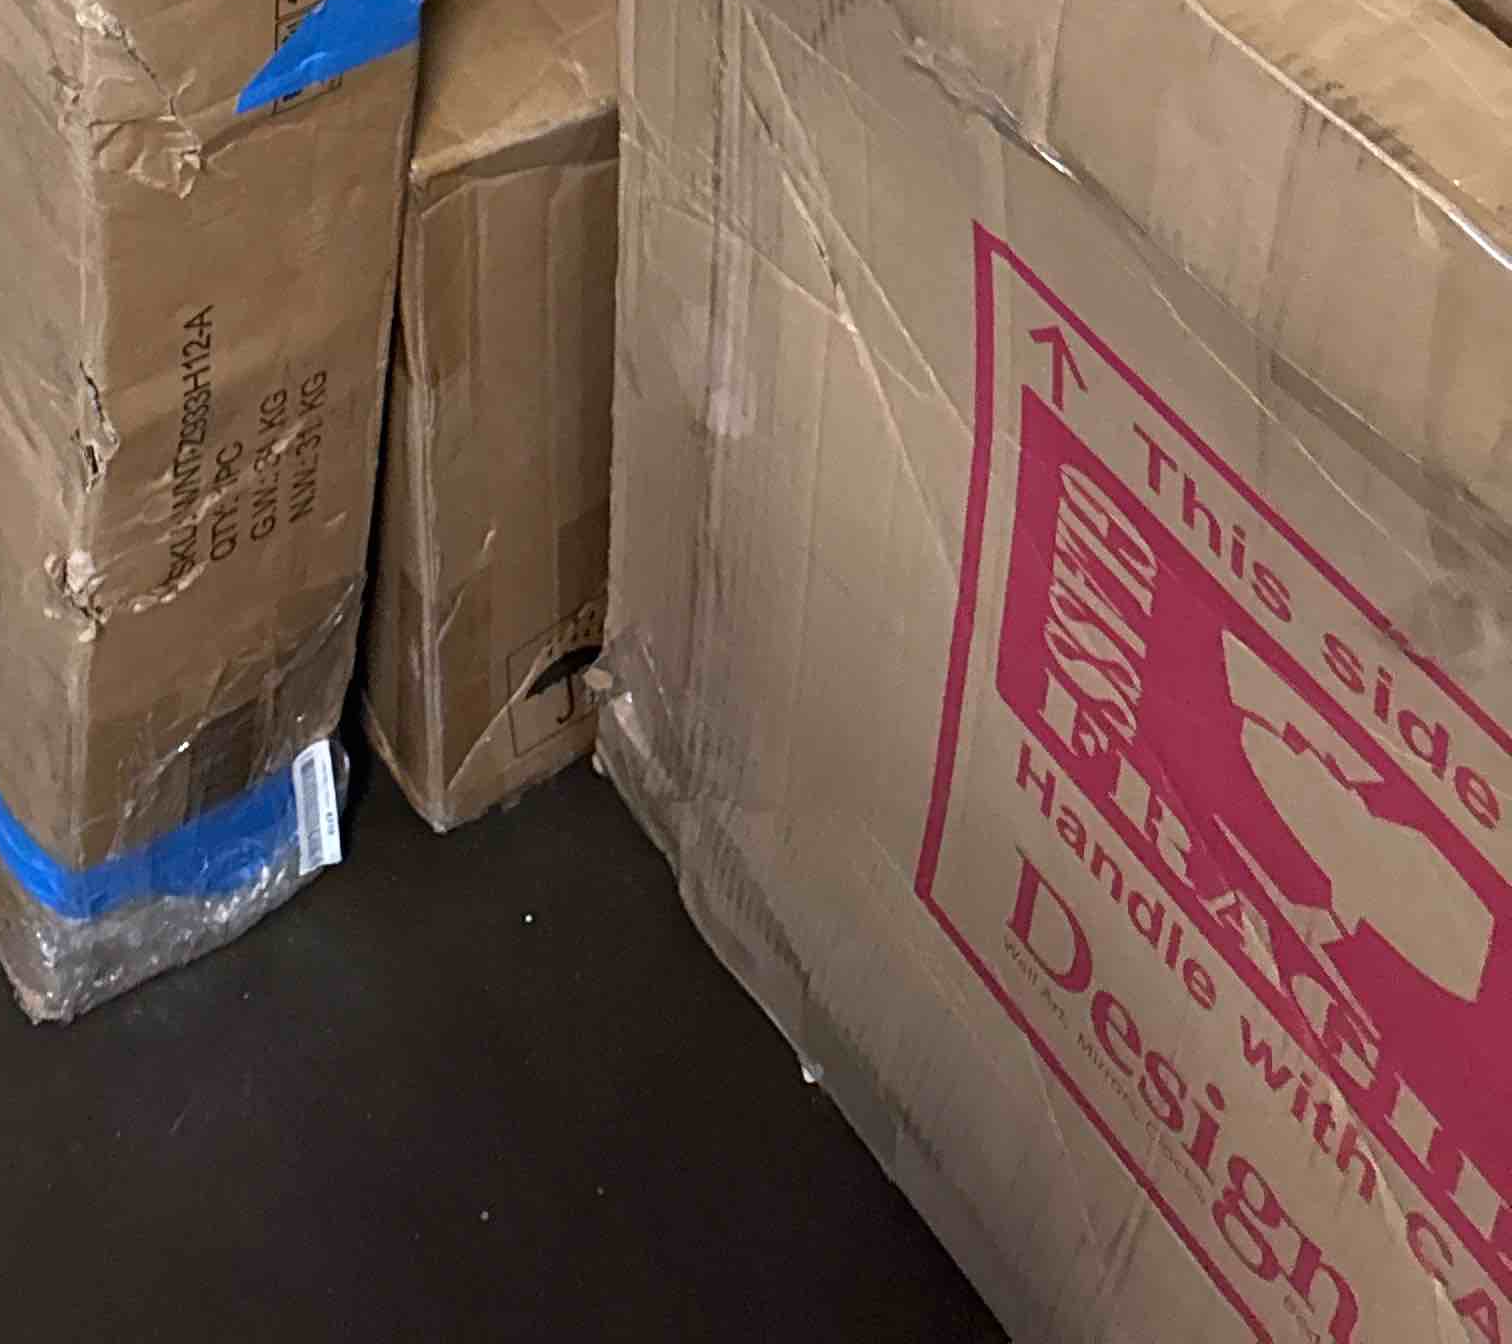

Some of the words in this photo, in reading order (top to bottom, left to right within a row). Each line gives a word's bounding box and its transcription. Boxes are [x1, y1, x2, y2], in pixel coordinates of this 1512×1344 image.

[259, 388, 288, 435] KG
[299, 369, 328, 417] KG
[1044, 463, 1159, 746] GLASS
[1133, 422, 1291, 624] This
[1321, 631, 1501, 830] side
[1005, 843, 1359, 1344] Design
[1016, 740, 1218, 1010] Handle
[1240, 1015, 1377, 1202] with
